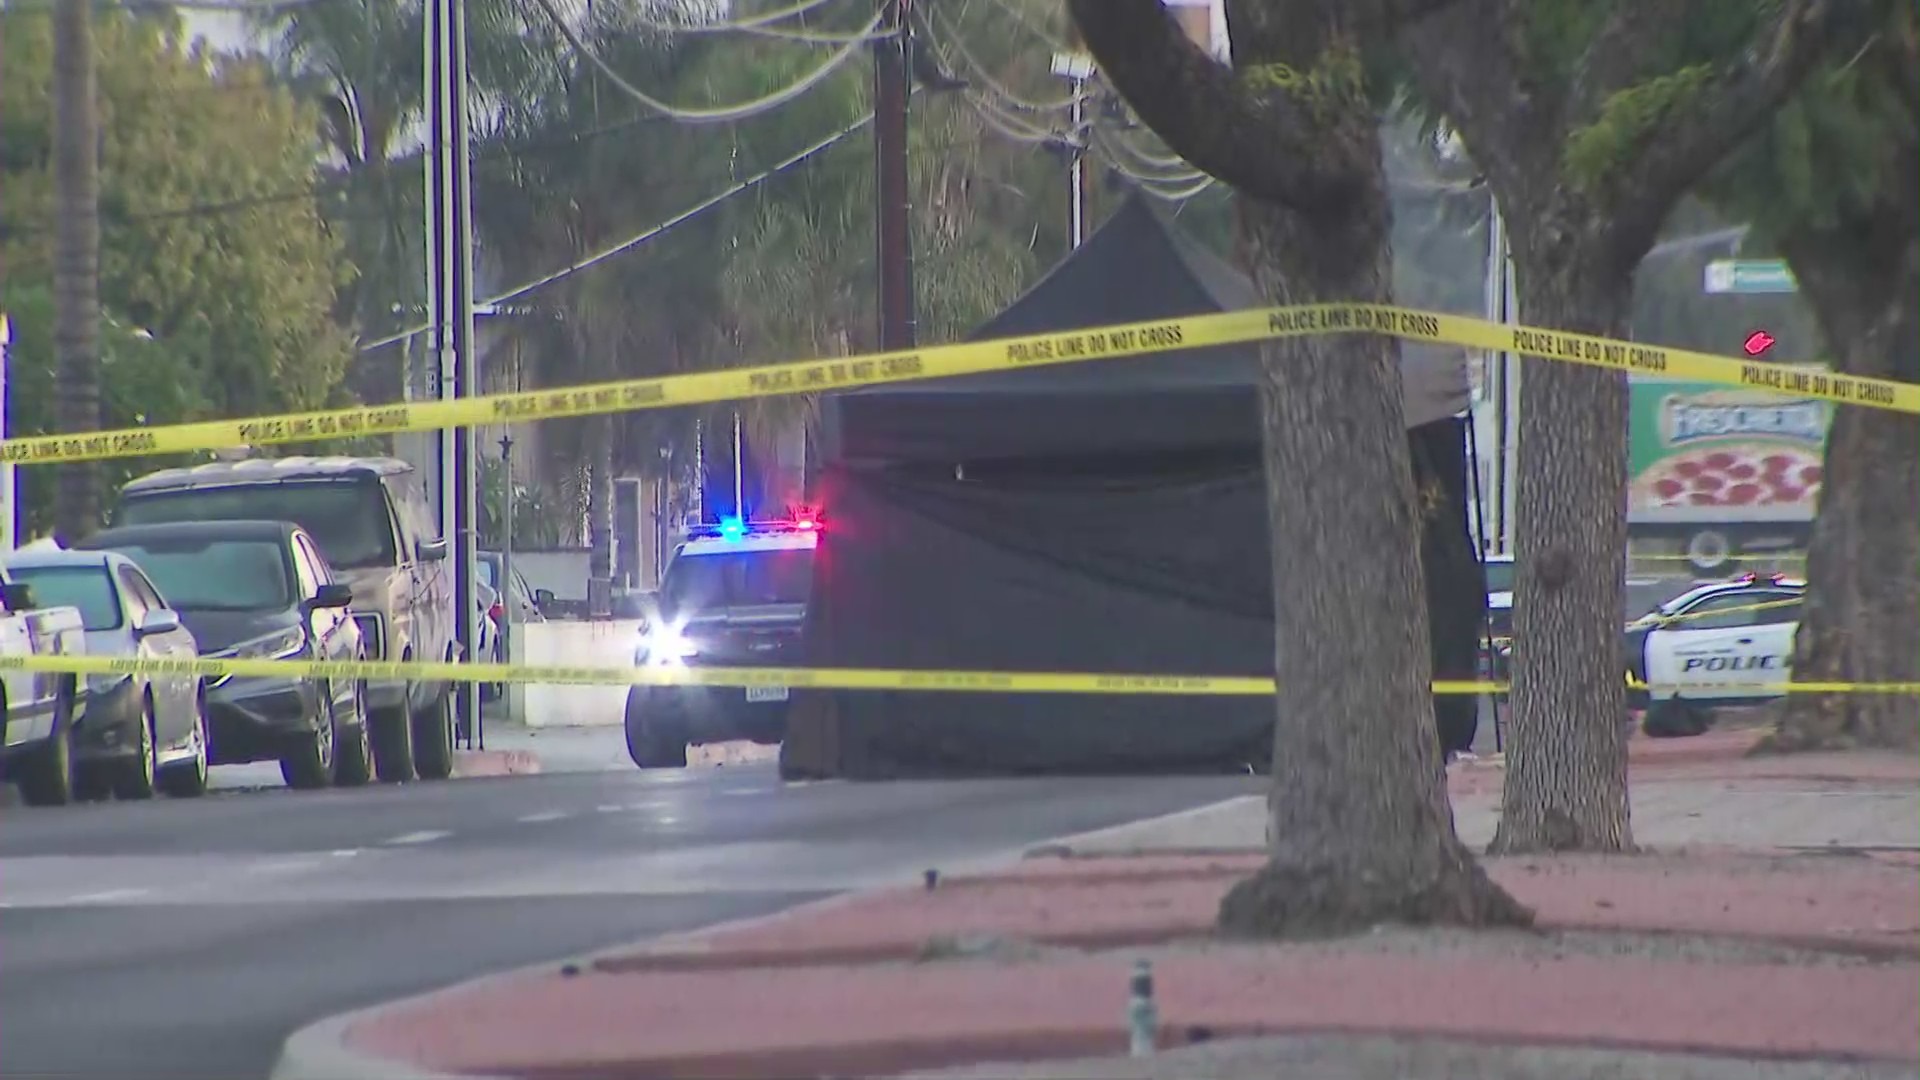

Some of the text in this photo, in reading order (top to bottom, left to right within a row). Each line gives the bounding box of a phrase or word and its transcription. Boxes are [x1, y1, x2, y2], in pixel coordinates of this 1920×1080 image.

[1269, 309, 1439, 336] POLICE LINE DO NOT CROSS
[1007, 325, 1182, 362] POLICE LINE DO NOT CROSS
[1513, 330, 1666, 370] POLICE LINE DO NOT CROSS
[750, 370, 793, 391] POLICE
[852, 360, 875, 380] NOT
[1741, 365, 1894, 404] POLICE LINE DO NOT CROSS
[493, 397, 536, 417] POLICE
[238, 408, 408, 442] POLICE LINE DO NOT CROSS
[32, 441, 63, 458] LINE
[63, 440, 83, 456] DO
[85, 437, 109, 453] NOT
[112, 433, 157, 452] CROSS
